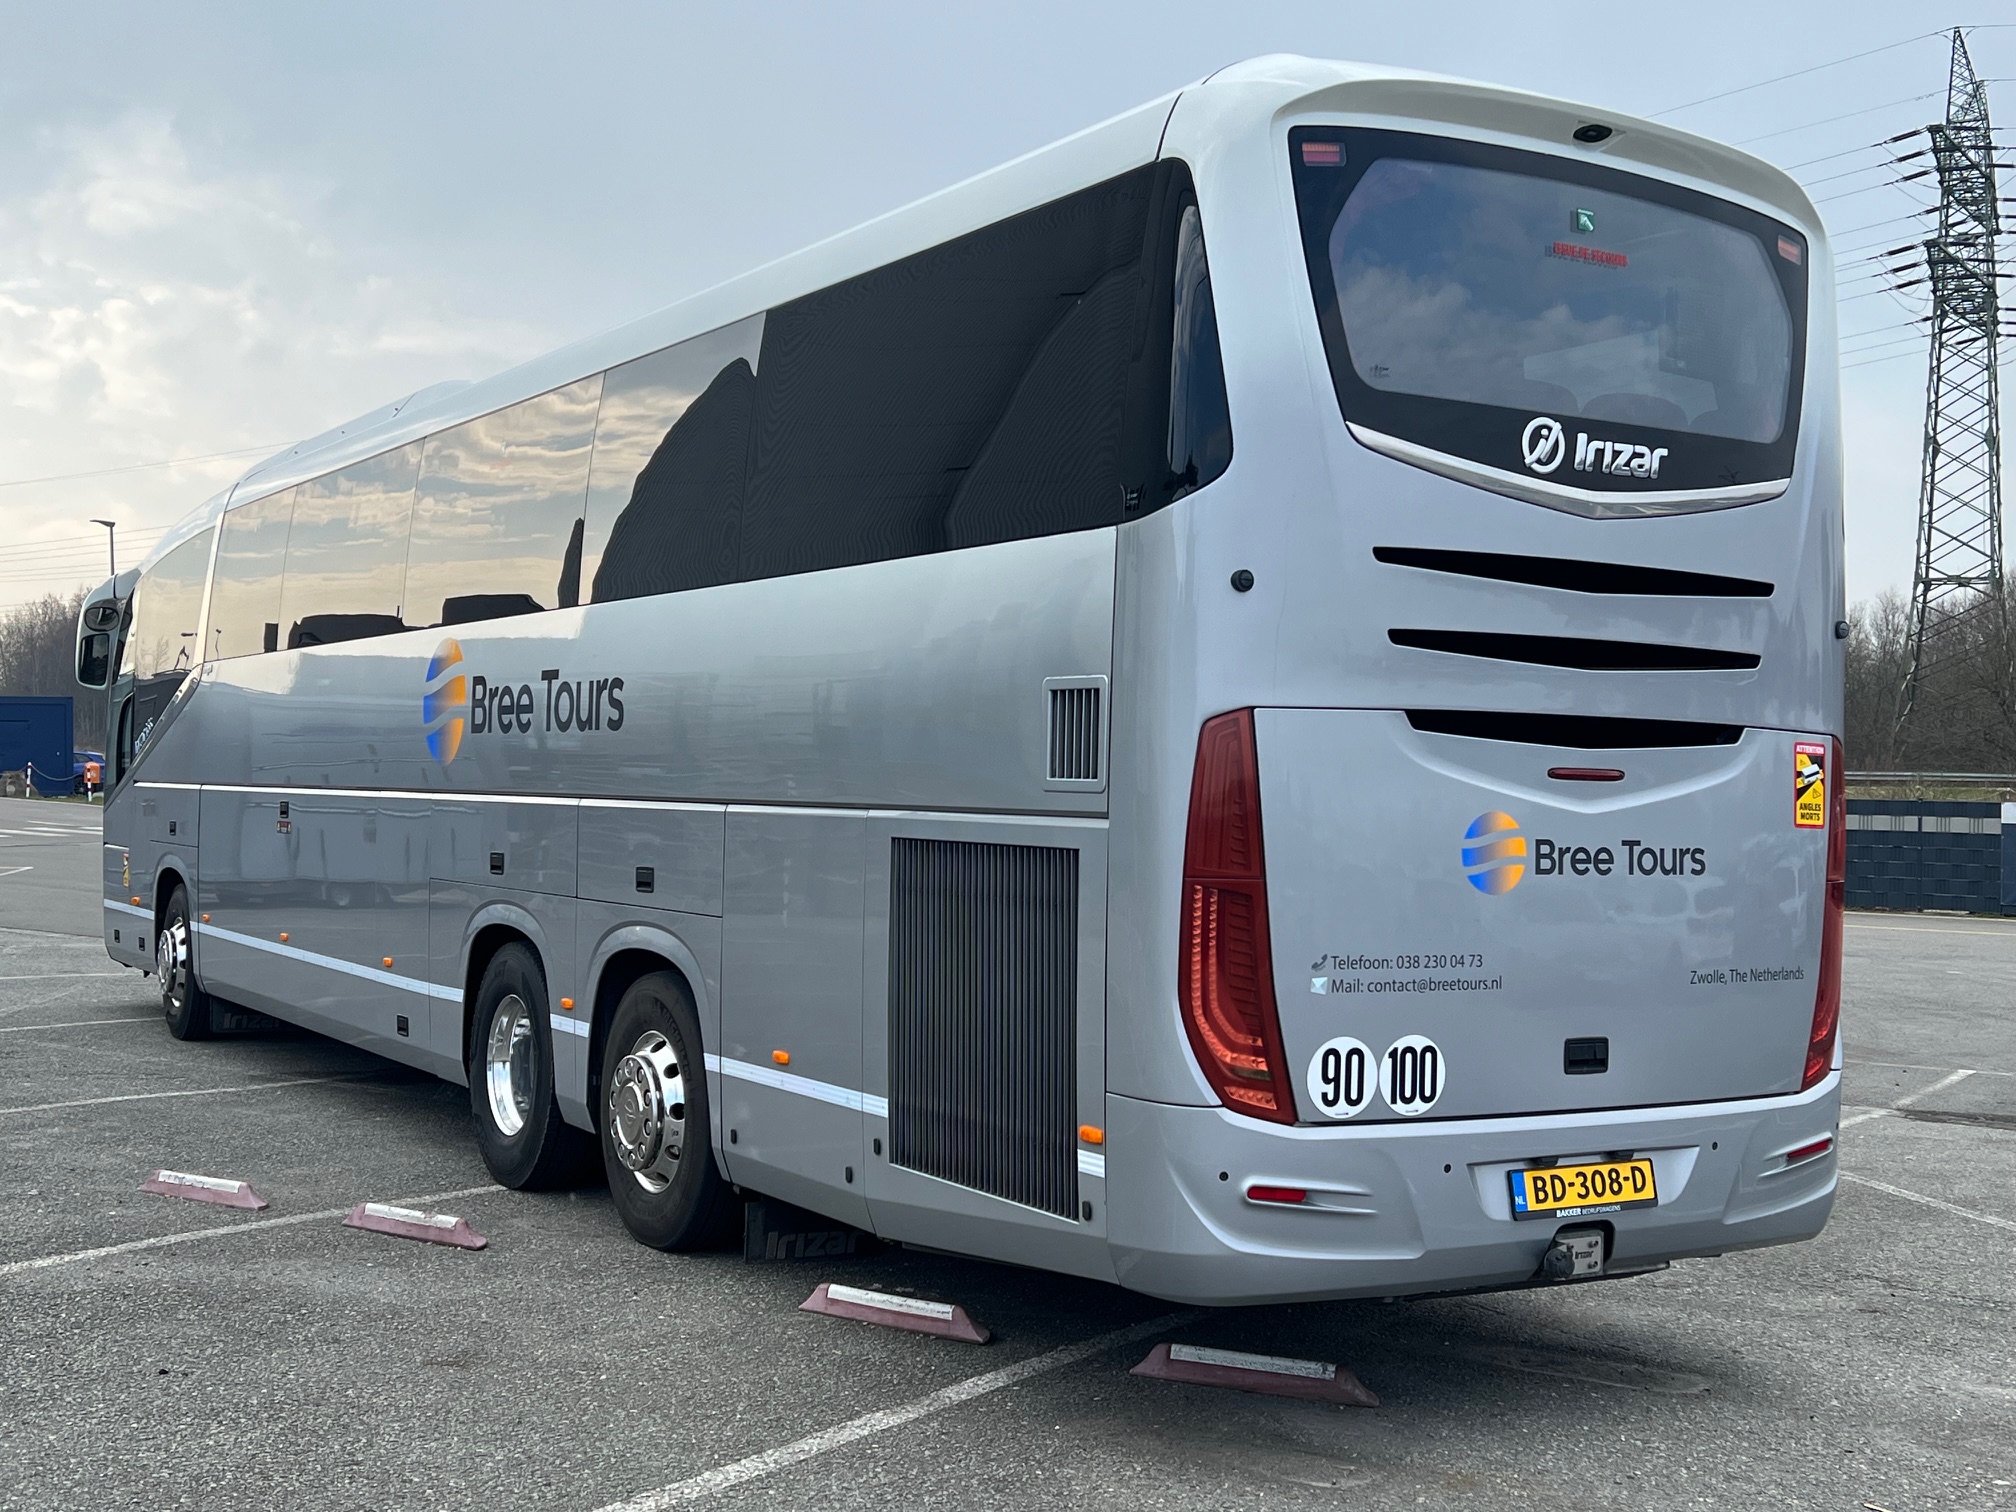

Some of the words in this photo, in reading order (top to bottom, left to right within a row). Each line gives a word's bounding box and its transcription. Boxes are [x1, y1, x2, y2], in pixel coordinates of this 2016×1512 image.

[1574, 432, 1669, 480] Irizar
[471, 675, 534, 735] Bree
[541, 669, 625, 734] Tours
[1800, 802, 1822, 812] ANGLES
[1800, 812, 1820, 822] MORTS
[1534, 838, 1615, 876] Bree
[1621, 839, 1706, 876] Tours
[1331, 955, 1394, 970] Telefoon:
[1396, 954, 1421, 969] 038
[1423, 954, 1447, 969] 230
[1450, 954, 1466, 968] 04
[1468, 953, 1484, 968] 73
[1331, 978, 1364, 993] Mail:
[1367, 975, 1503, 994] contact@breetours.nl
[1690, 968, 1728, 985] Zwolle,
[1729, 968, 1748, 983] The
[1750, 966, 1805, 982] Netherlands
[1321, 1047, 1365, 1107] 90
[1388, 1045, 1438, 1105] 100
[1532, 1165, 1647, 1205] BD-308-D
[1515, 1195, 1526, 1205] NL
[1556, 1207, 1582, 1218] BAKKER
